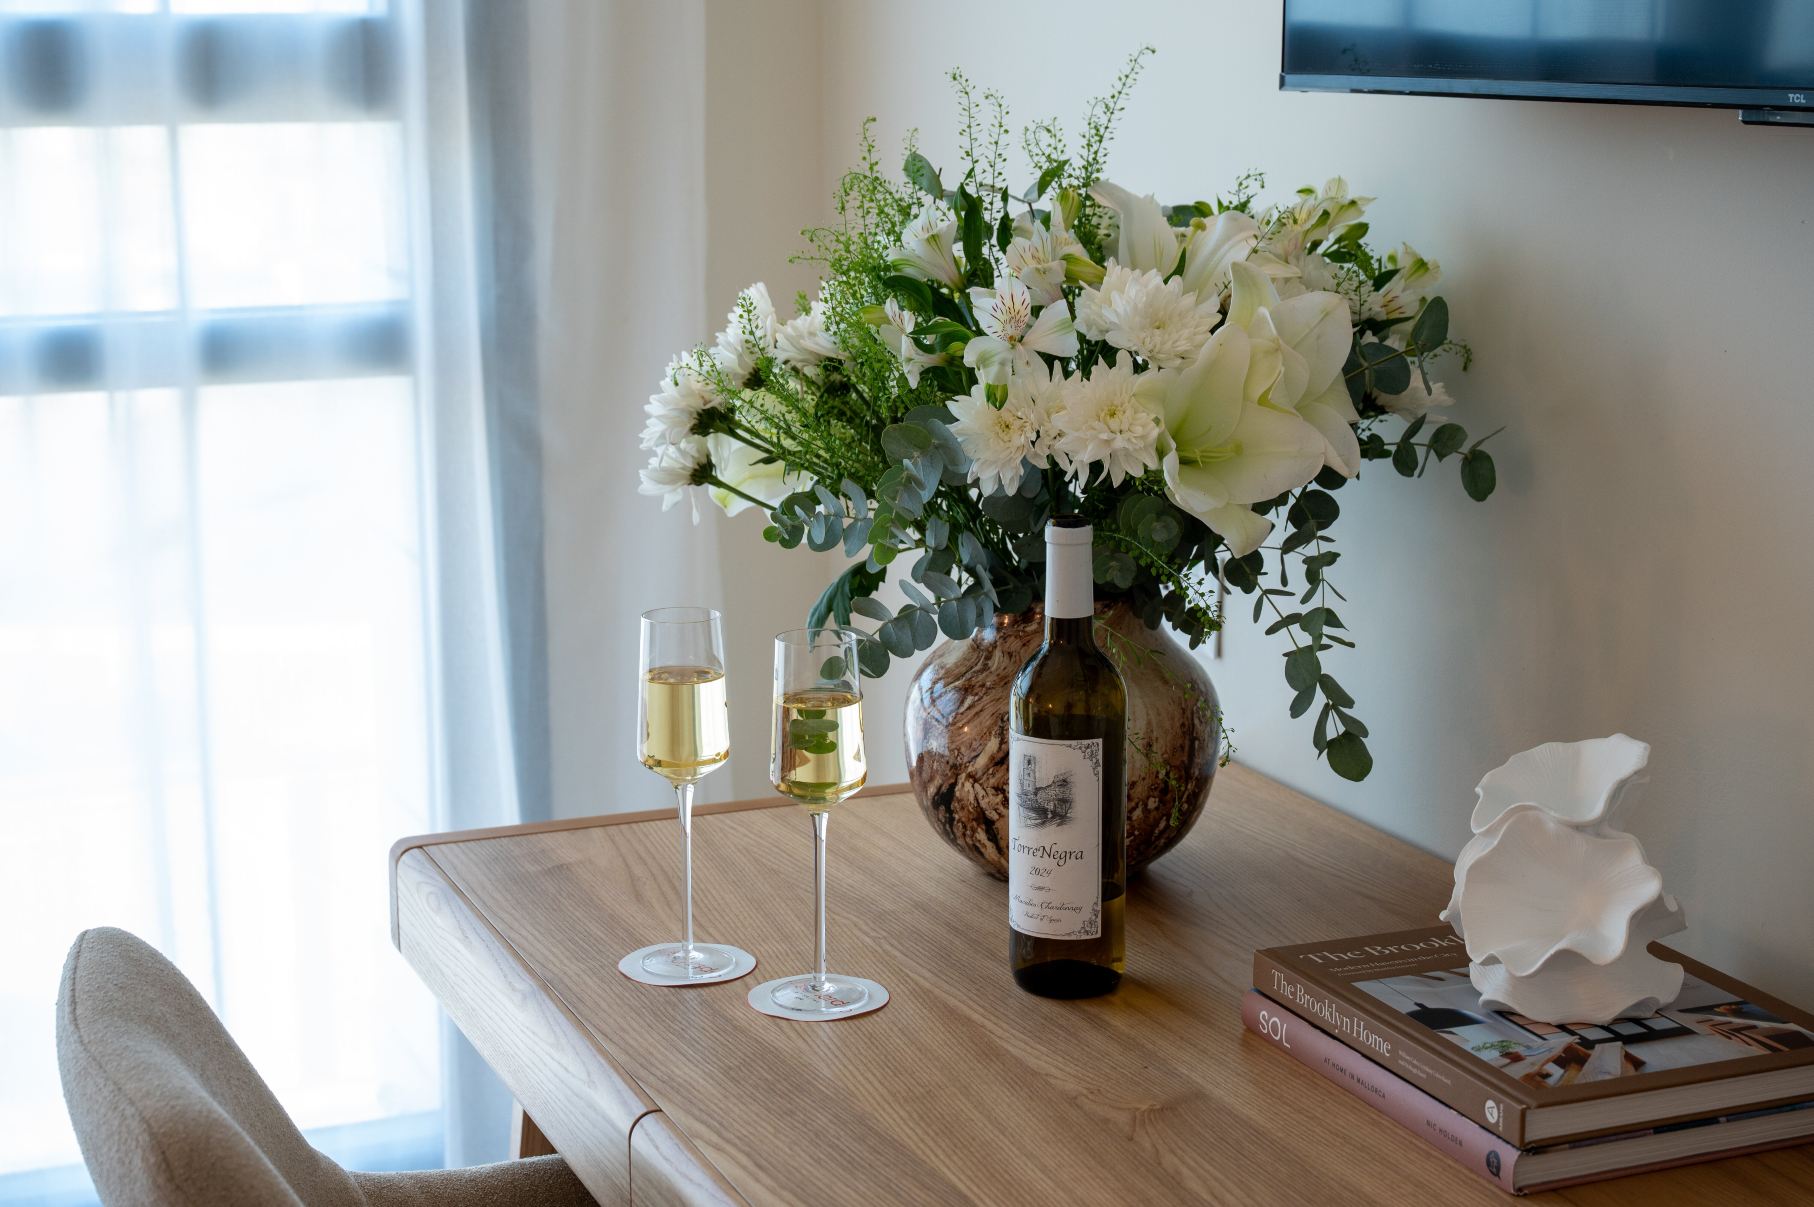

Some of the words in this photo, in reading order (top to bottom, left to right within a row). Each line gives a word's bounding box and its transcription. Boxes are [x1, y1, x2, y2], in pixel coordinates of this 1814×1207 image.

[1787, 93, 1806, 103] TCL
[1029, 866, 1053, 878] 2024
[1299, 950, 1366, 963] The
[1364, 935, 1466, 957] Brookl
[1271, 969, 1295, 999] The
[1295, 984, 1350, 1033] Brooklyn
[1353, 1017, 1391, 1056] Home
[1259, 1010, 1291, 1049] SOL
[1324, 1056, 1330, 1066] AT
[1331, 1062, 1347, 1076] HOME
[1348, 1071, 1355, 1081] IN
[1356, 1075, 1386, 1100] MALLORCA
[1425, 1119, 1438, 1132] NIC
[1438, 1127, 1464, 1148] HOLDEN
